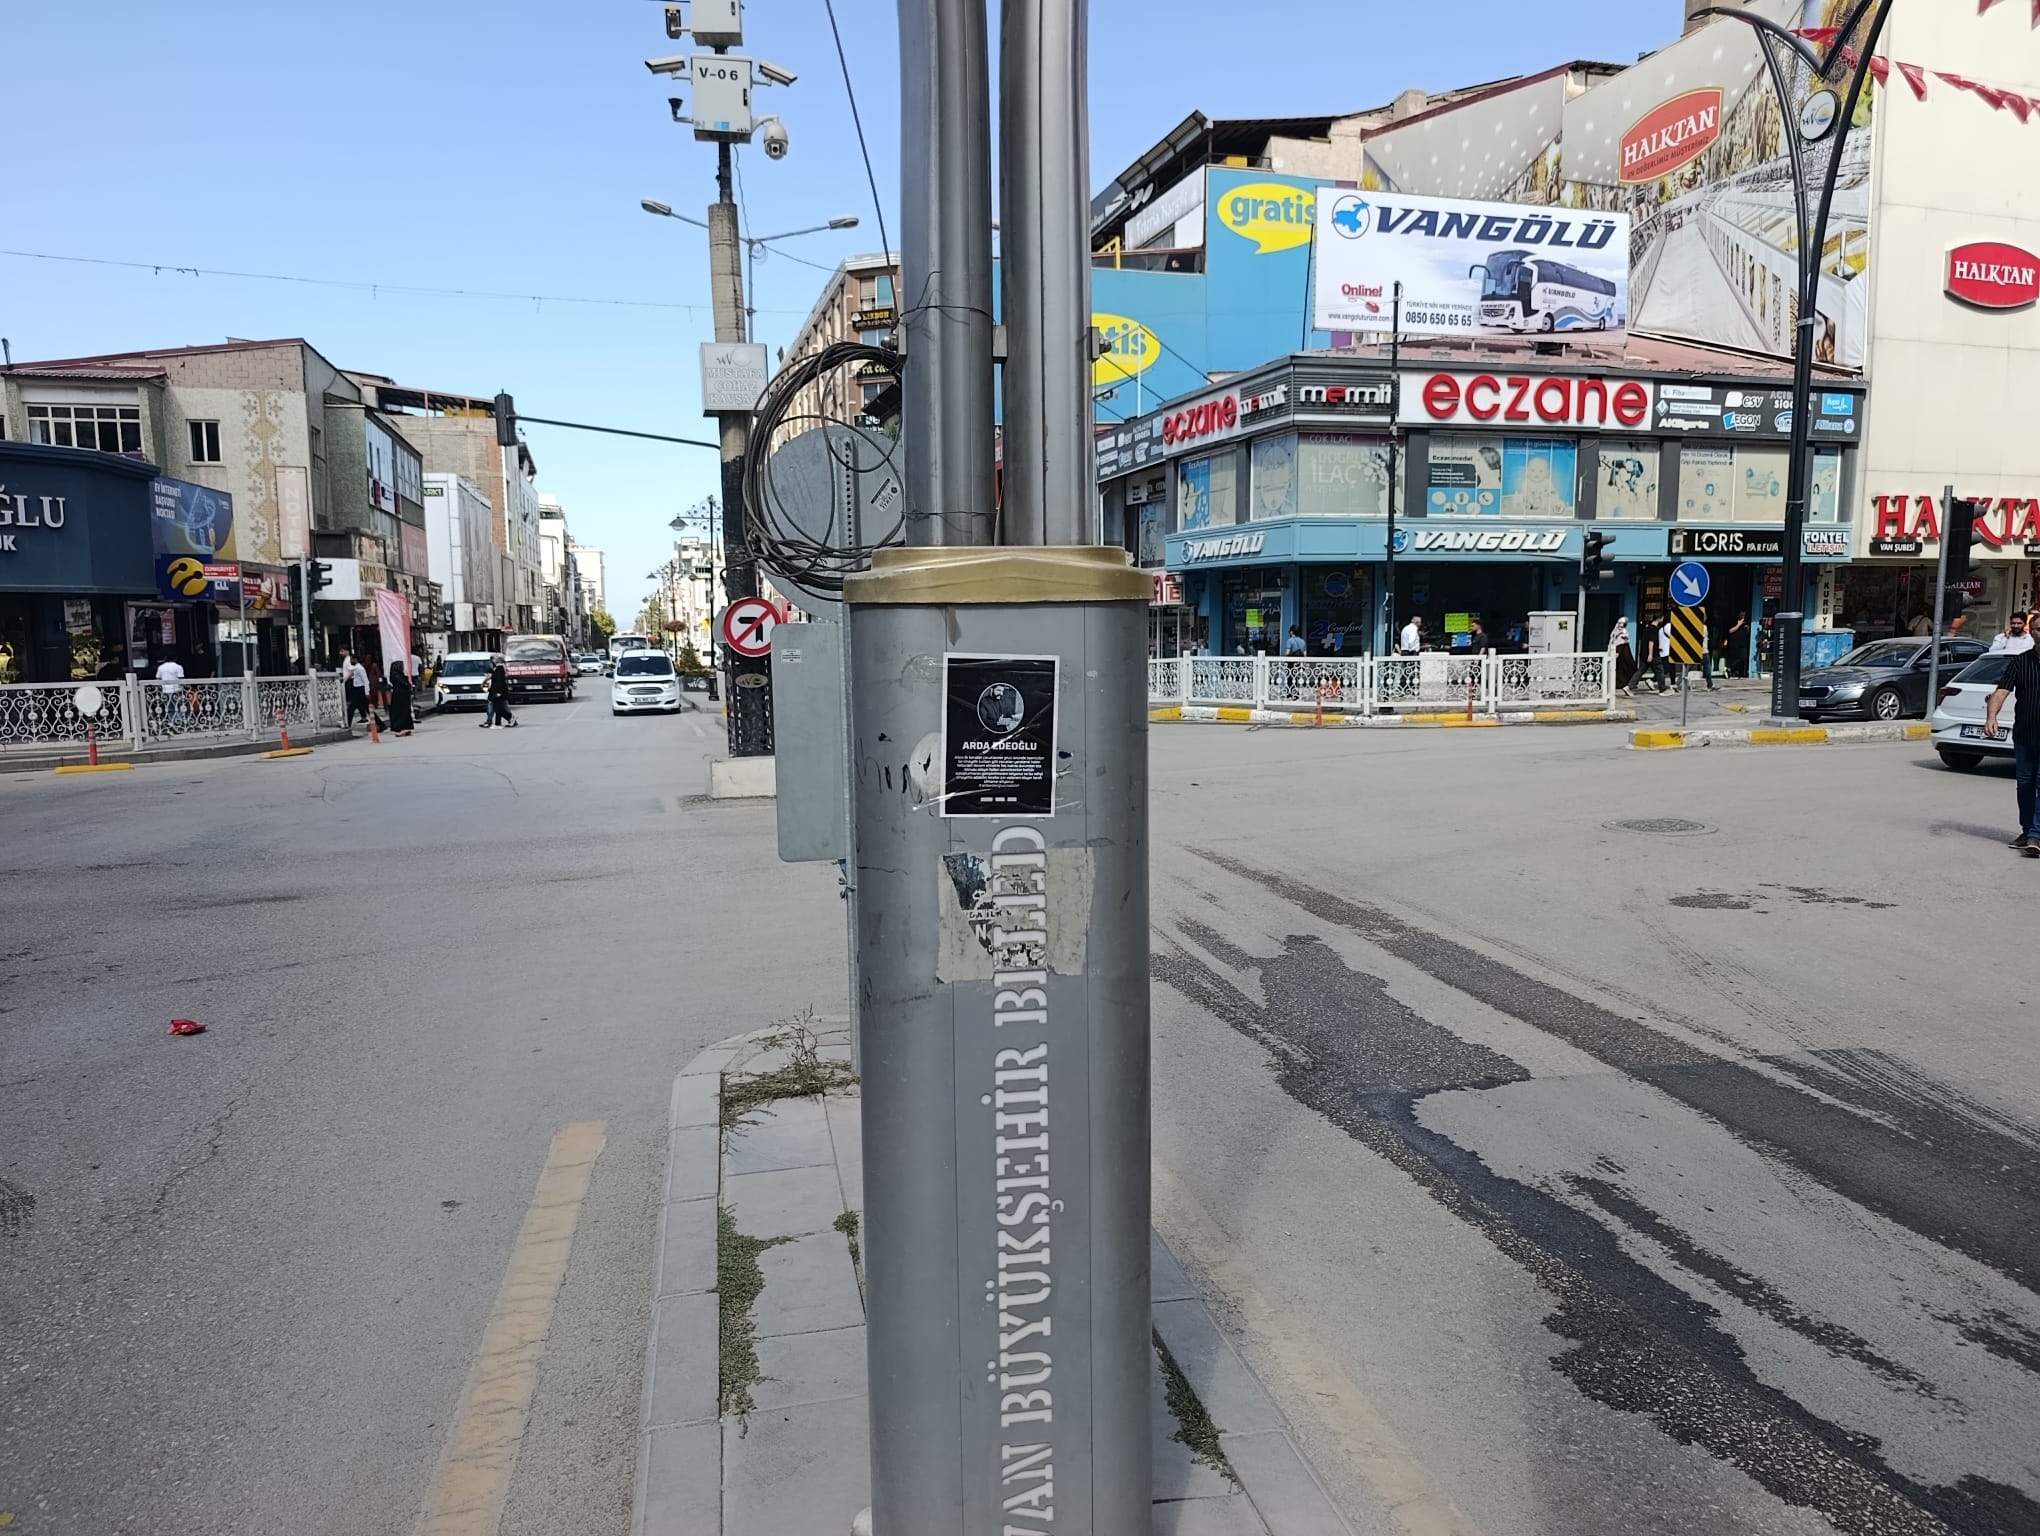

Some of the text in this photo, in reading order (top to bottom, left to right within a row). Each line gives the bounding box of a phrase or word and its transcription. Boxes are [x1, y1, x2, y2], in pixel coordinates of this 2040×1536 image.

[1623, 105, 1718, 168] HALKTAN
[1230, 195, 1315, 227] gratis
[1375, 205, 1617, 250] VANGÖLÜ
[1954, 260, 2036, 287] HALKTAN
[1341, 283, 1383, 298] Online!
[1405, 311, 1472, 327] 0850 650 65 65
[1422, 373, 1649, 426] eczane
[1162, 394, 1238, 446] eczane
[1192, 531, 1266, 560] VANGÖLÜ
[1414, 528, 1569, 553] VANGÖLÜ
[1746, 542, 1779, 552] PARFUM
[1803, 531, 1849, 544] FONTEL
[1879, 541, 1916, 553] VAN ŞUBESİ
[962, 741, 990, 751] ARDA
[980, 1042, 1064, 1427] BÜYÜKŞEHİR
